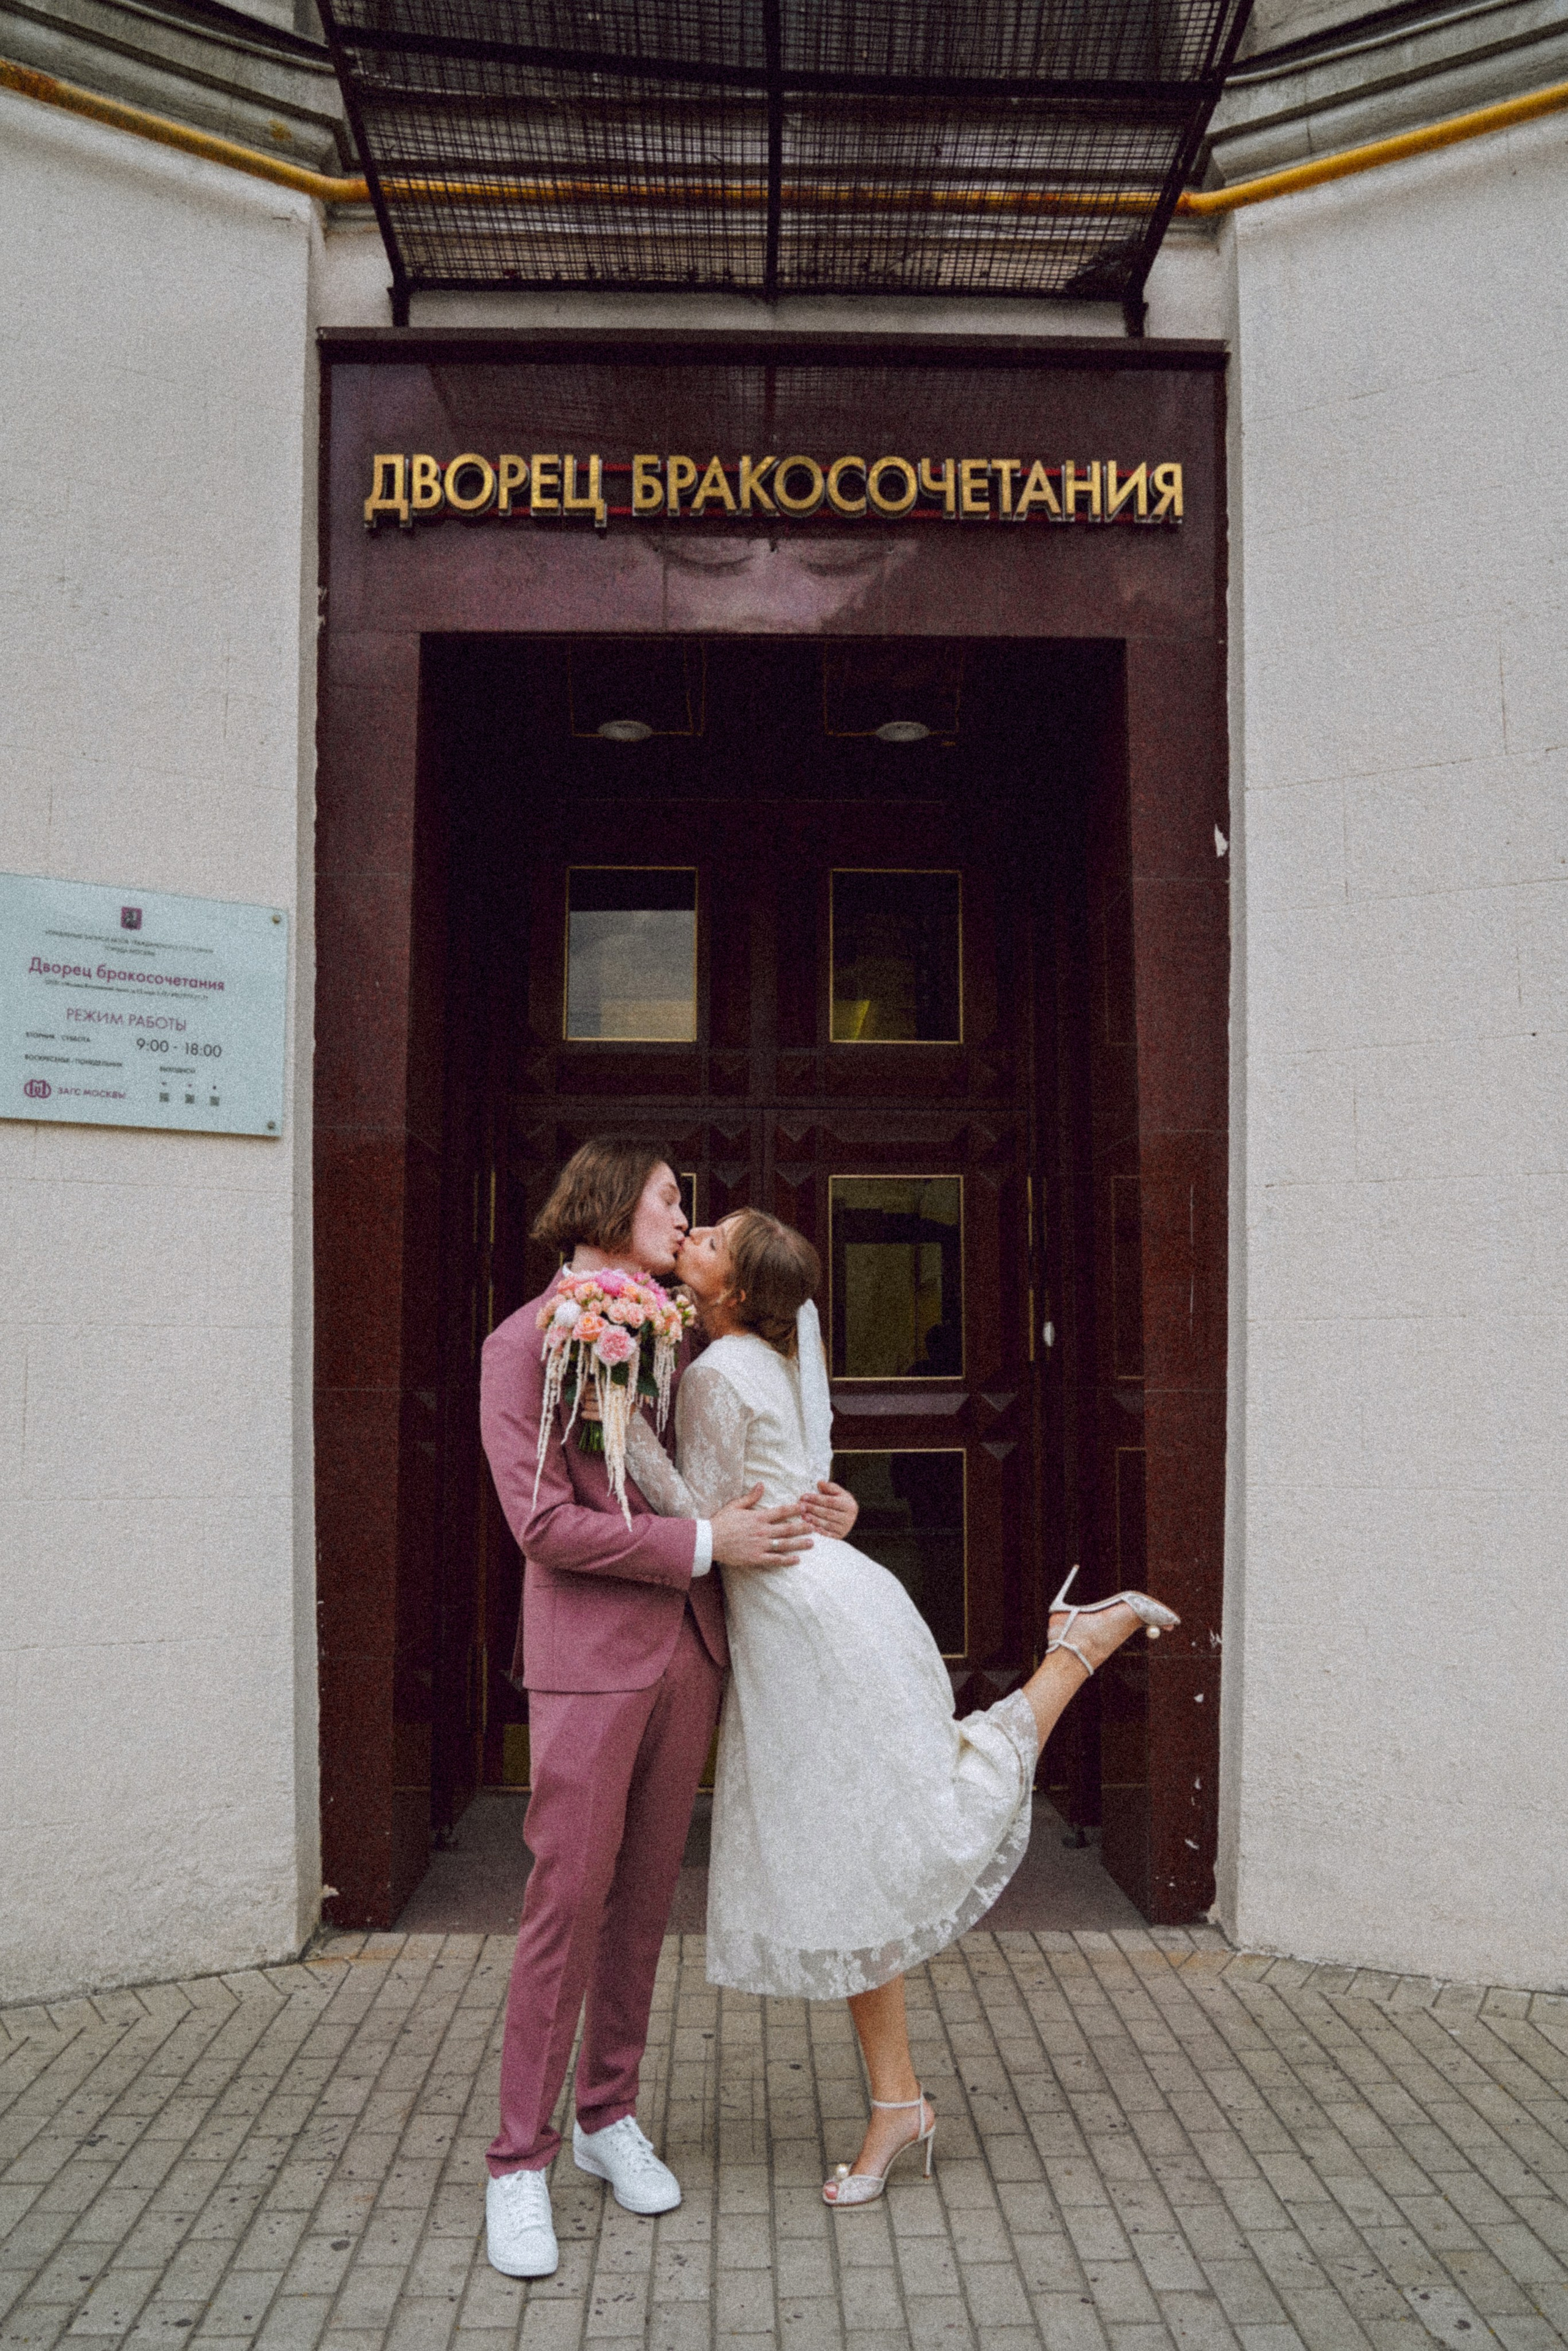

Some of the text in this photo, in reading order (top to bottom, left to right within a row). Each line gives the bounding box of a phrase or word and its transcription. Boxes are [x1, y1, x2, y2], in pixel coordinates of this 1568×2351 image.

[364, 453, 1185, 521] ДВОРЕЦ БРАКОСОЧЕТАНИЯ
[29, 956, 92, 978] Дворец
[97, 964, 225, 991] бракосочетания
[67, 1008, 186, 1032] РЕЖИМ РАБОТЫ
[136, 1038, 169, 1053] 9:00
[185, 1042, 222, 1057] 18:00
[58, 1087, 126, 1098] ЗАГС МОСКВЫ
